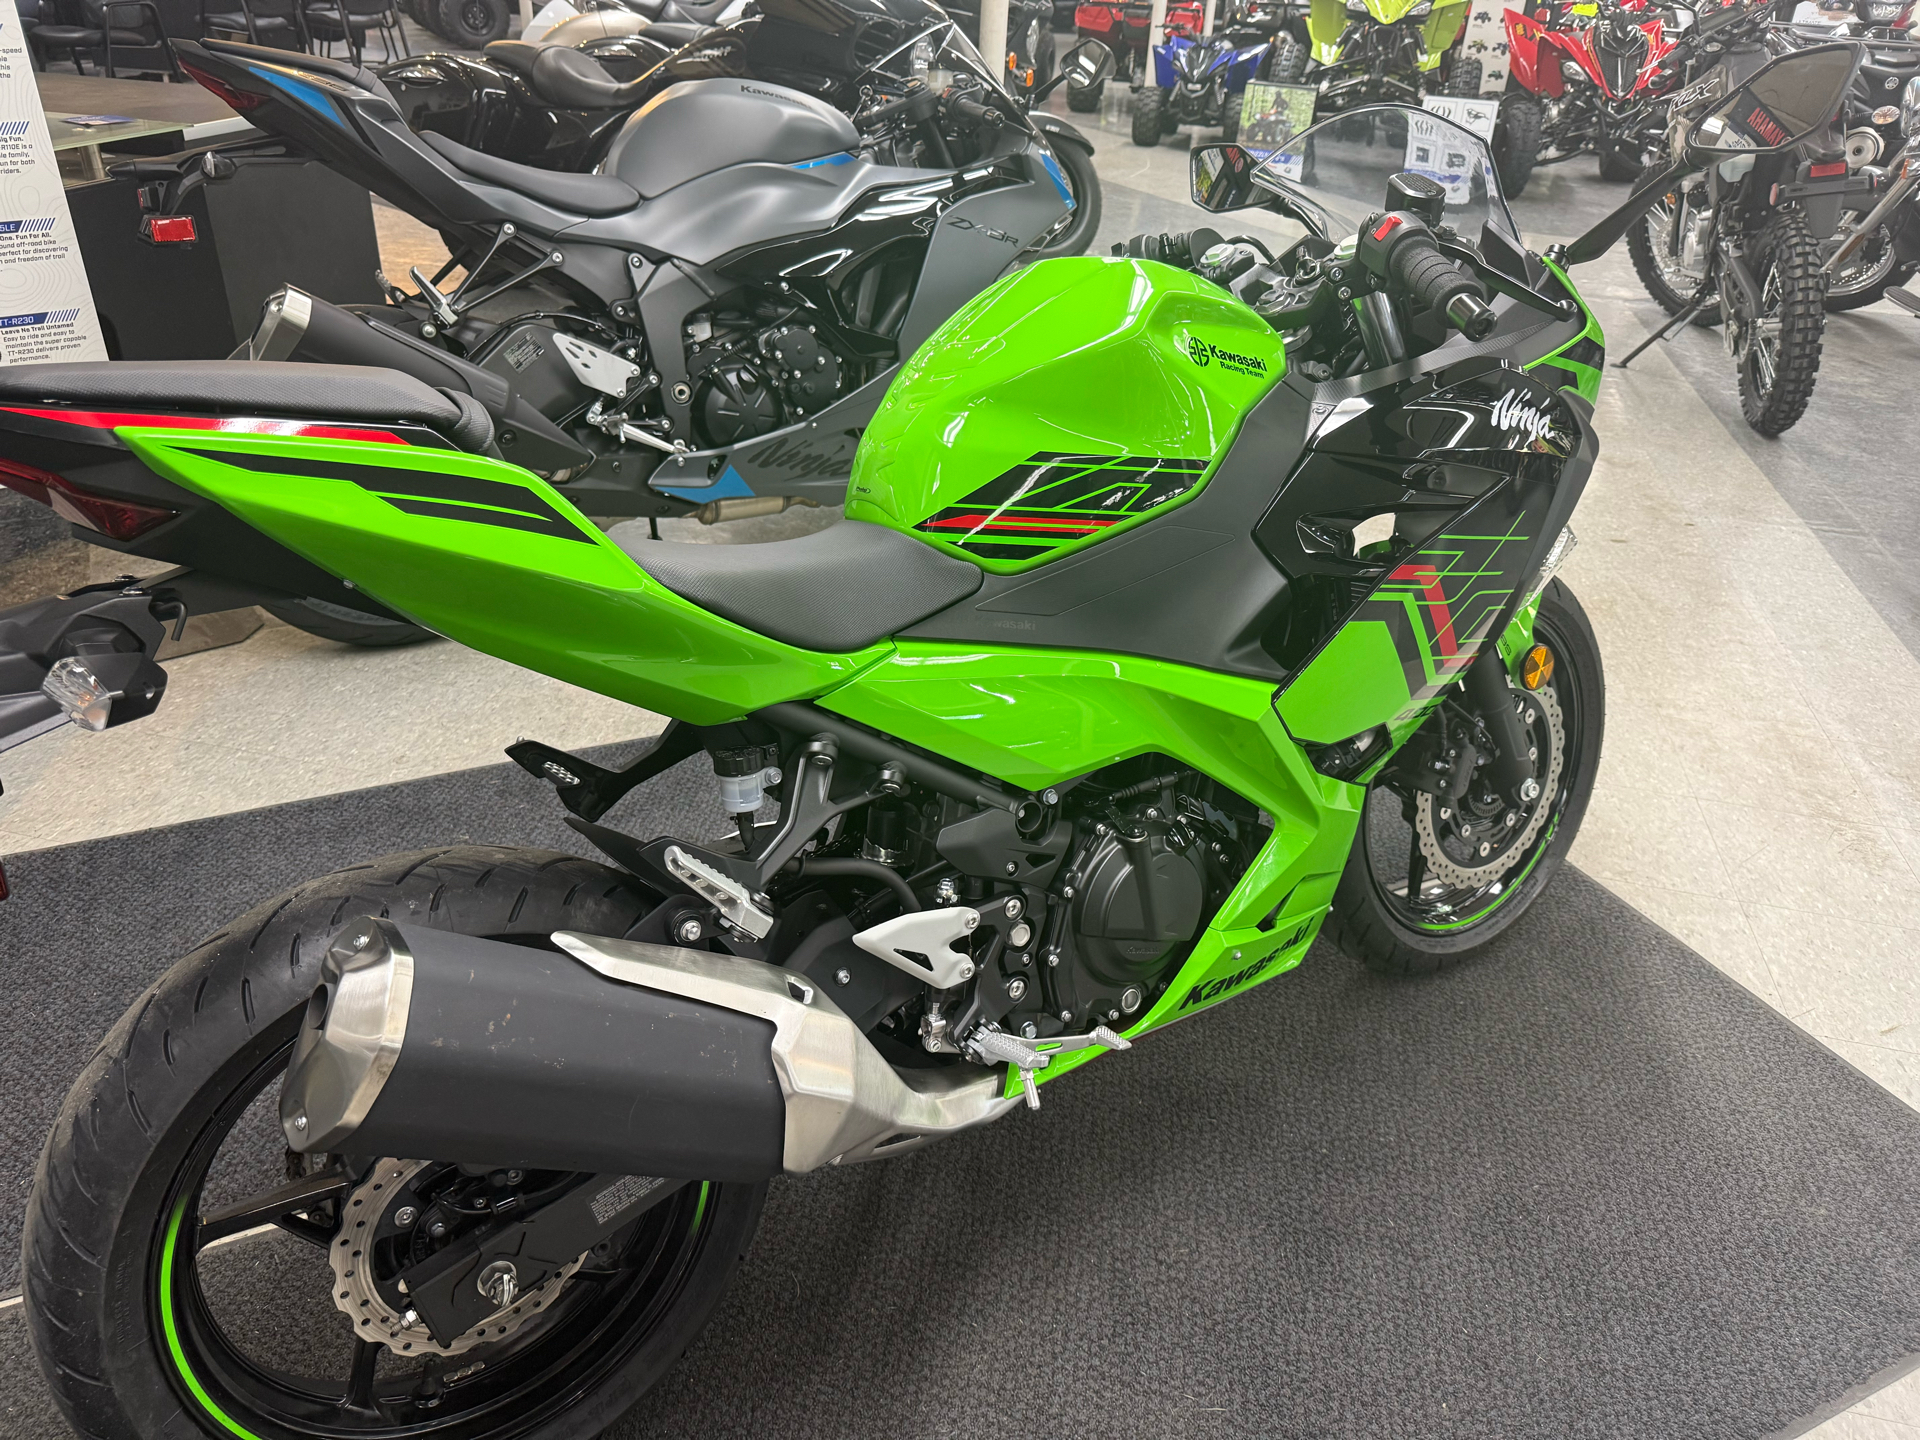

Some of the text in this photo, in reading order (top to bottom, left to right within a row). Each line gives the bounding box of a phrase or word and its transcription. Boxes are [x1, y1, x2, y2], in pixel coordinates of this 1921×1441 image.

[20, 158, 36, 166] both
[16, 240, 43, 248] off-road
[32, 246, 69, 255] discovering
[17, 255, 44, 263] freedom
[46, 322, 74, 331] Untamed
[6, 341, 33, 350] maintain
[45, 338, 62, 346] super
[63, 335, 87, 343] capable
[8, 343, 81, 357] TT-R230 delivers proven
[9, 354, 51, 364] performance.
[1208, 344, 1267, 372] Kawasaki
[1219, 360, 1265, 379] Racing Team
[1490, 388, 1555, 448] Ninja
[747, 437, 853, 482] Ninja
[1178, 916, 1315, 1012] Kawasaki
